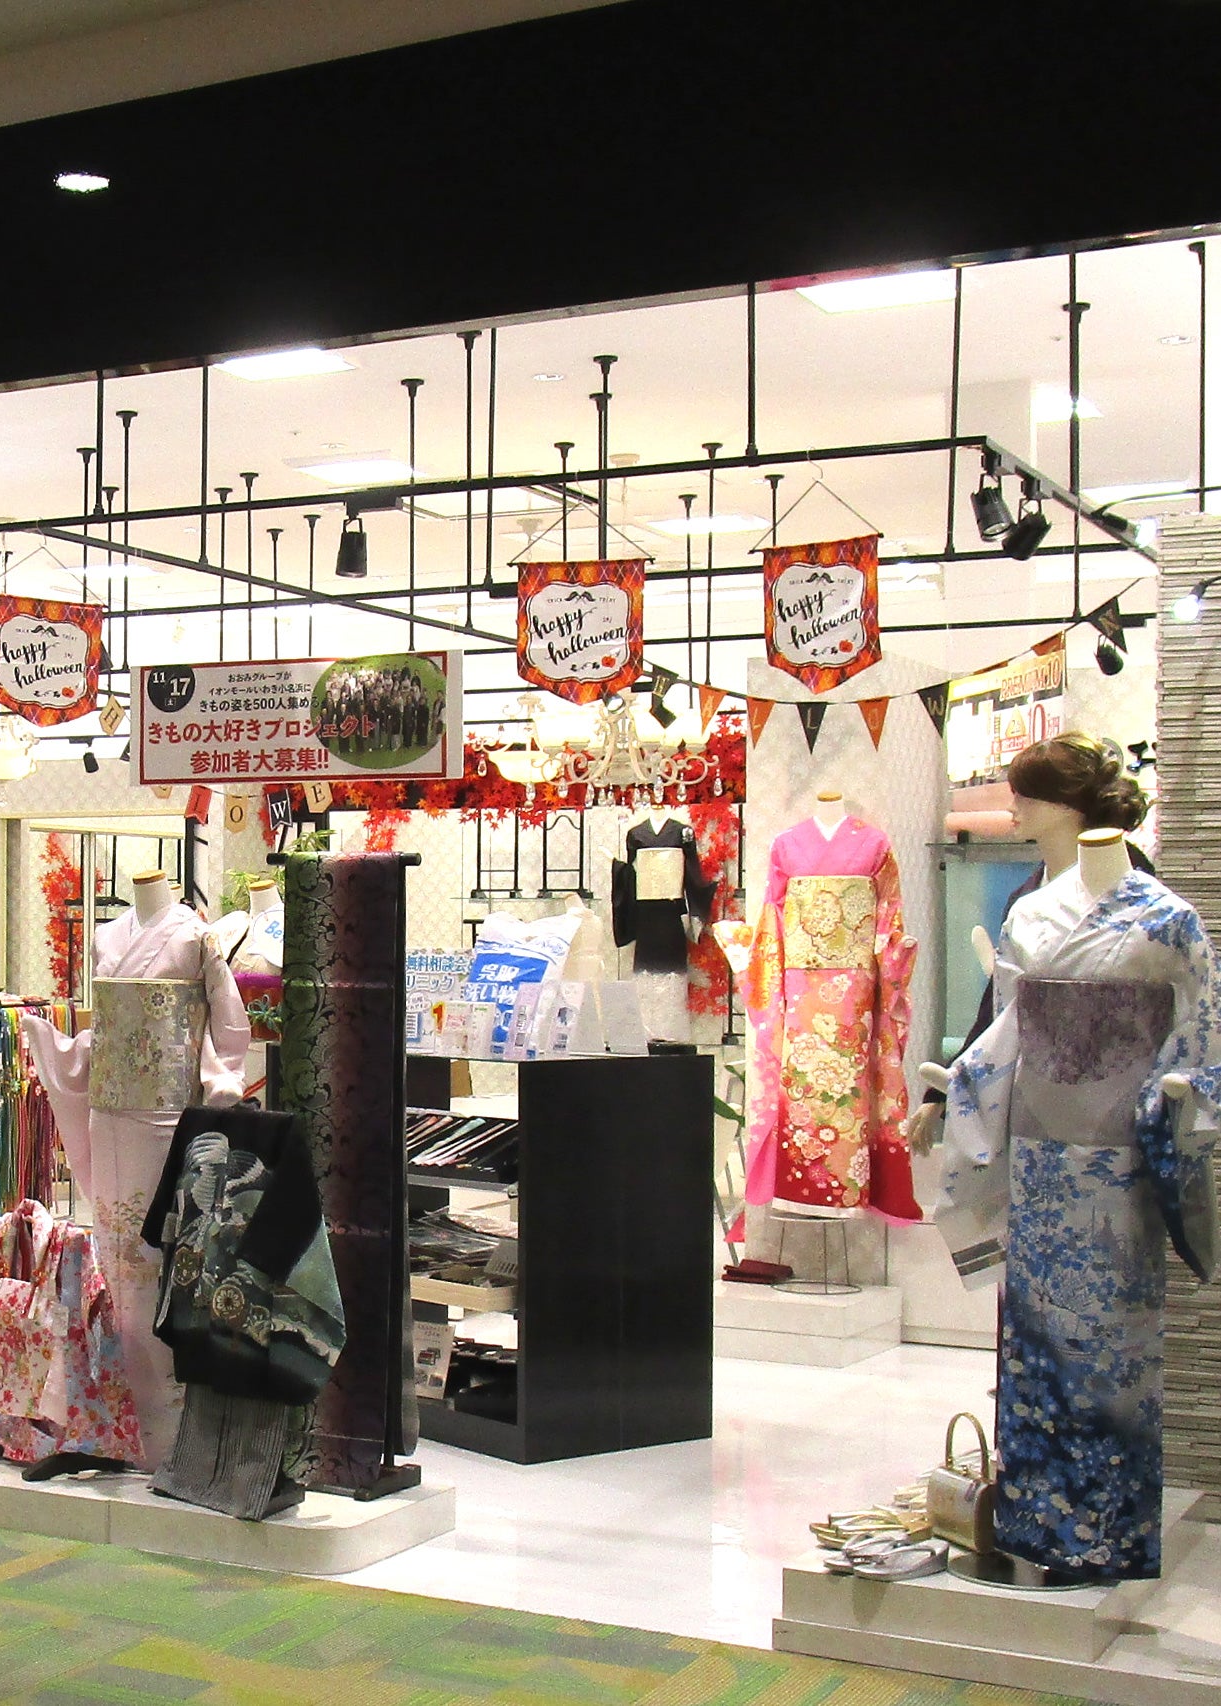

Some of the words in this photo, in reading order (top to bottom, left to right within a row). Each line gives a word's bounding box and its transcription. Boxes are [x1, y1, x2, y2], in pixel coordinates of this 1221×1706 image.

[778, 590, 829, 623] happy
[533, 608, 590, 640] happy
[790, 608, 861, 650] halloween
[2, 641, 53, 664] happy
[546, 627, 626, 666] halloween
[13, 663, 84, 689] halloween
[152, 671, 166, 684] 11
[170, 676, 191, 697] 17
[208, 682, 312, 696] イオンモールいわき小名浜に
[228, 671, 293, 684] おおみグループが
[199, 696, 320, 713] きもの姿を500人集める
[927, 694, 945, 716] W
[147, 714, 375, 745] きもの大好きプロジェクト
[190, 747, 329, 774] 参加者大募集!!
[229, 804, 244, 824] O
[271, 800, 288, 821] W
